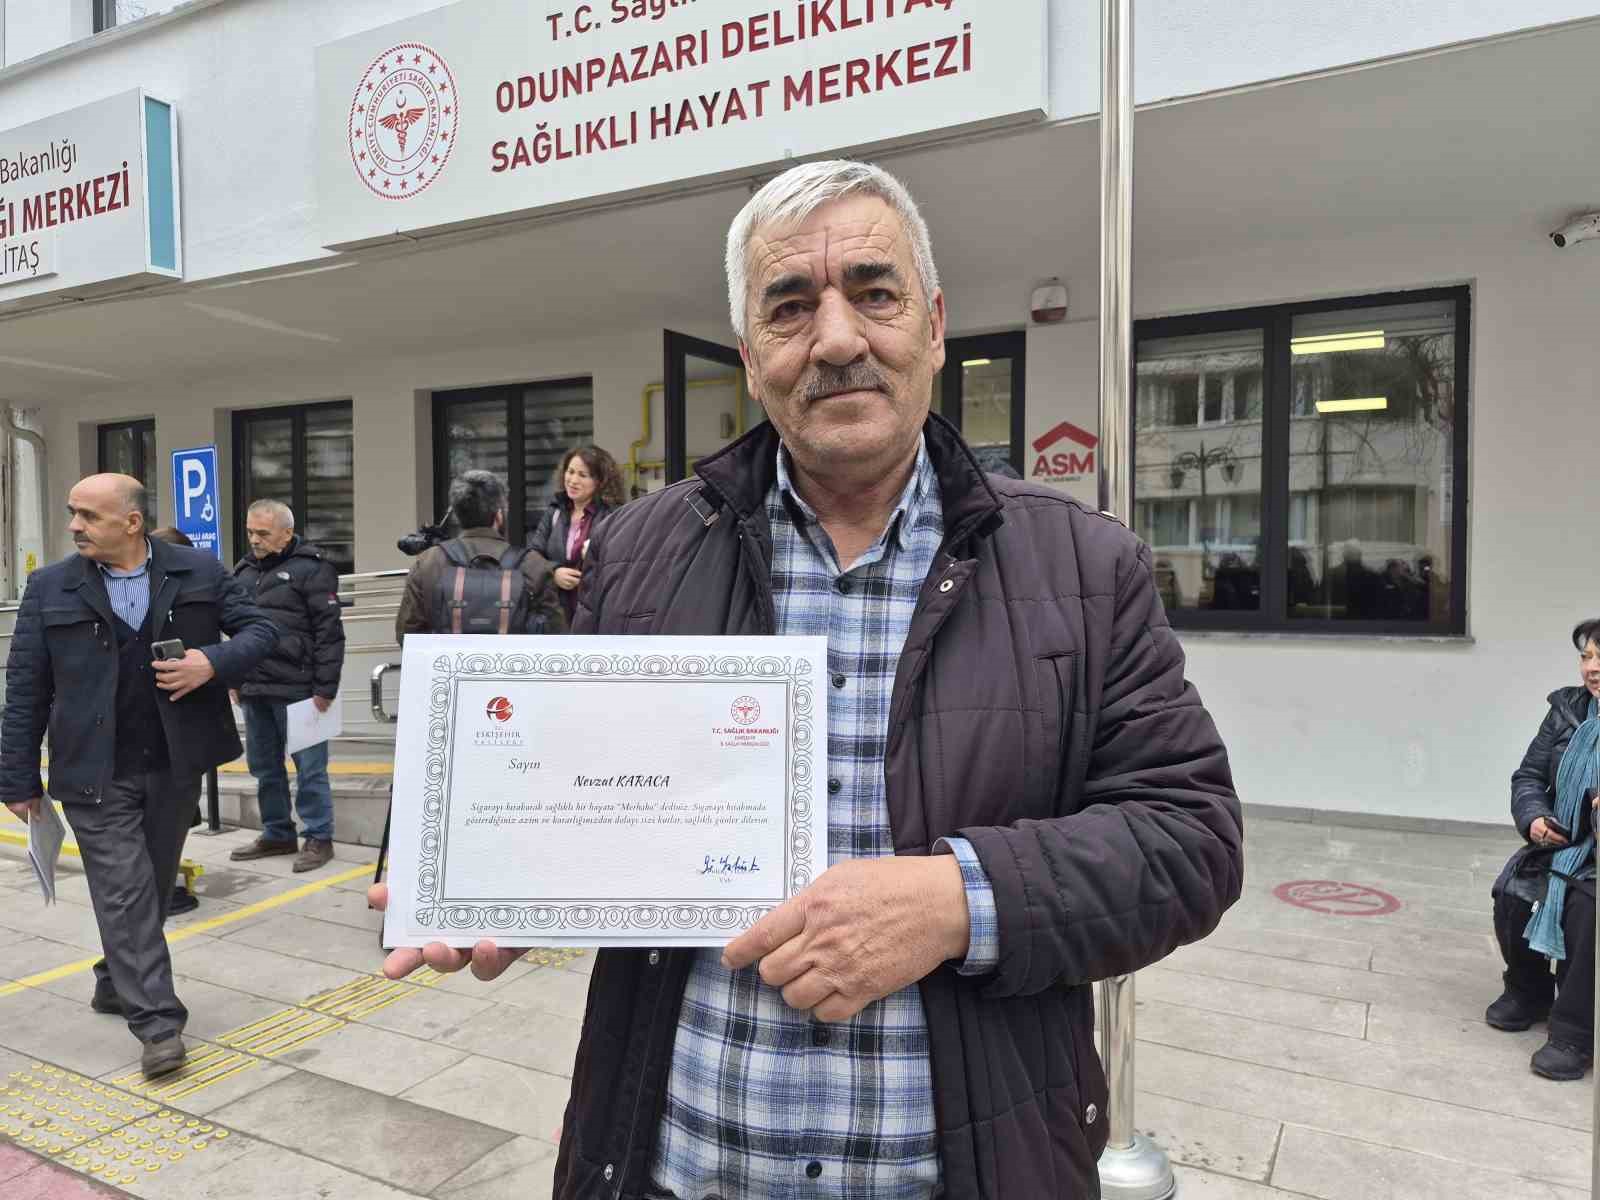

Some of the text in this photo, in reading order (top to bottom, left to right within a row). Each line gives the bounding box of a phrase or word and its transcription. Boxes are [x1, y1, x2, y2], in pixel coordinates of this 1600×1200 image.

[546, 5, 600, 40] T.C.
[496, 30, 708, 113] ODUNPAZARI
[491, 22, 972, 172] SAĞLIKLI HAYAT MERKEZİ
[0, 138, 77, 184] Bakanlığı
[22, 160, 130, 233] MERKEZİ
[0, 241, 40, 275] İTAŞ
[1031, 451, 1095, 477] ASM
[182, 458, 207, 518] P
[508, 757, 541, 774] Sayın
[573, 775, 671, 788] Nevzat KARACA
